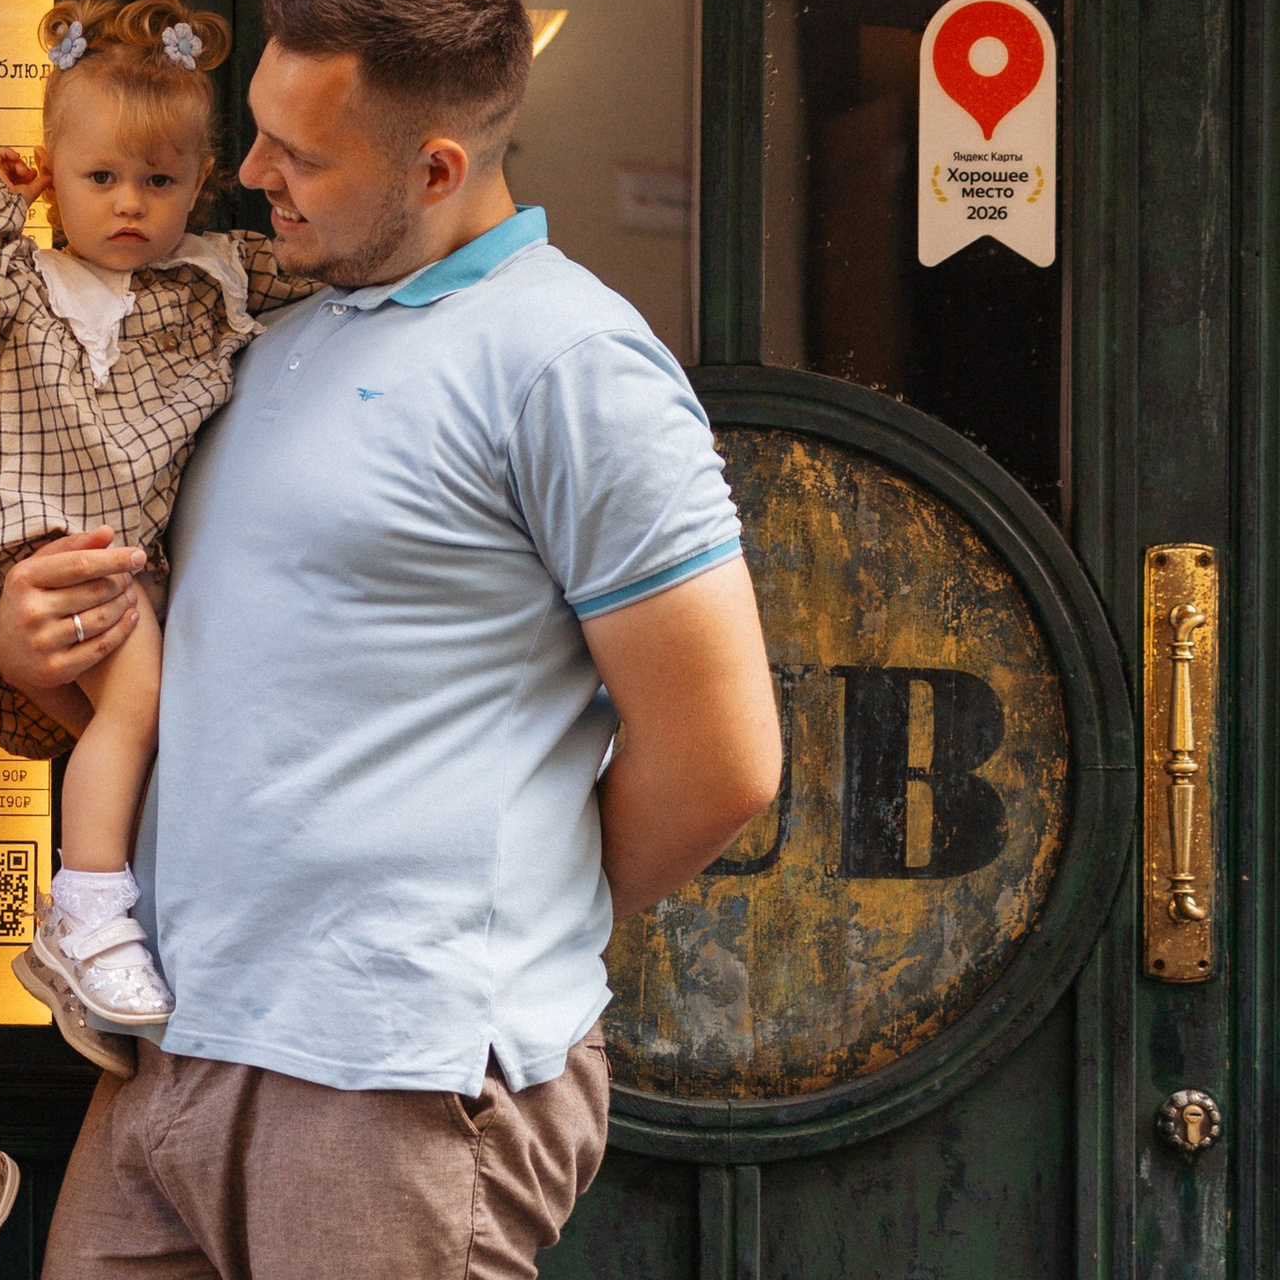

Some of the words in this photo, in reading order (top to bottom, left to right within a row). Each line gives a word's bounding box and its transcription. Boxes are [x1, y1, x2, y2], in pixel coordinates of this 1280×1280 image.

[952, 151, 989, 163] Яндекс
[990, 151, 1023, 163] Карты
[946, 167, 1029, 186] Хорошее
[961, 187, 1015, 199] место
[966, 205, 1008, 221] 2026
